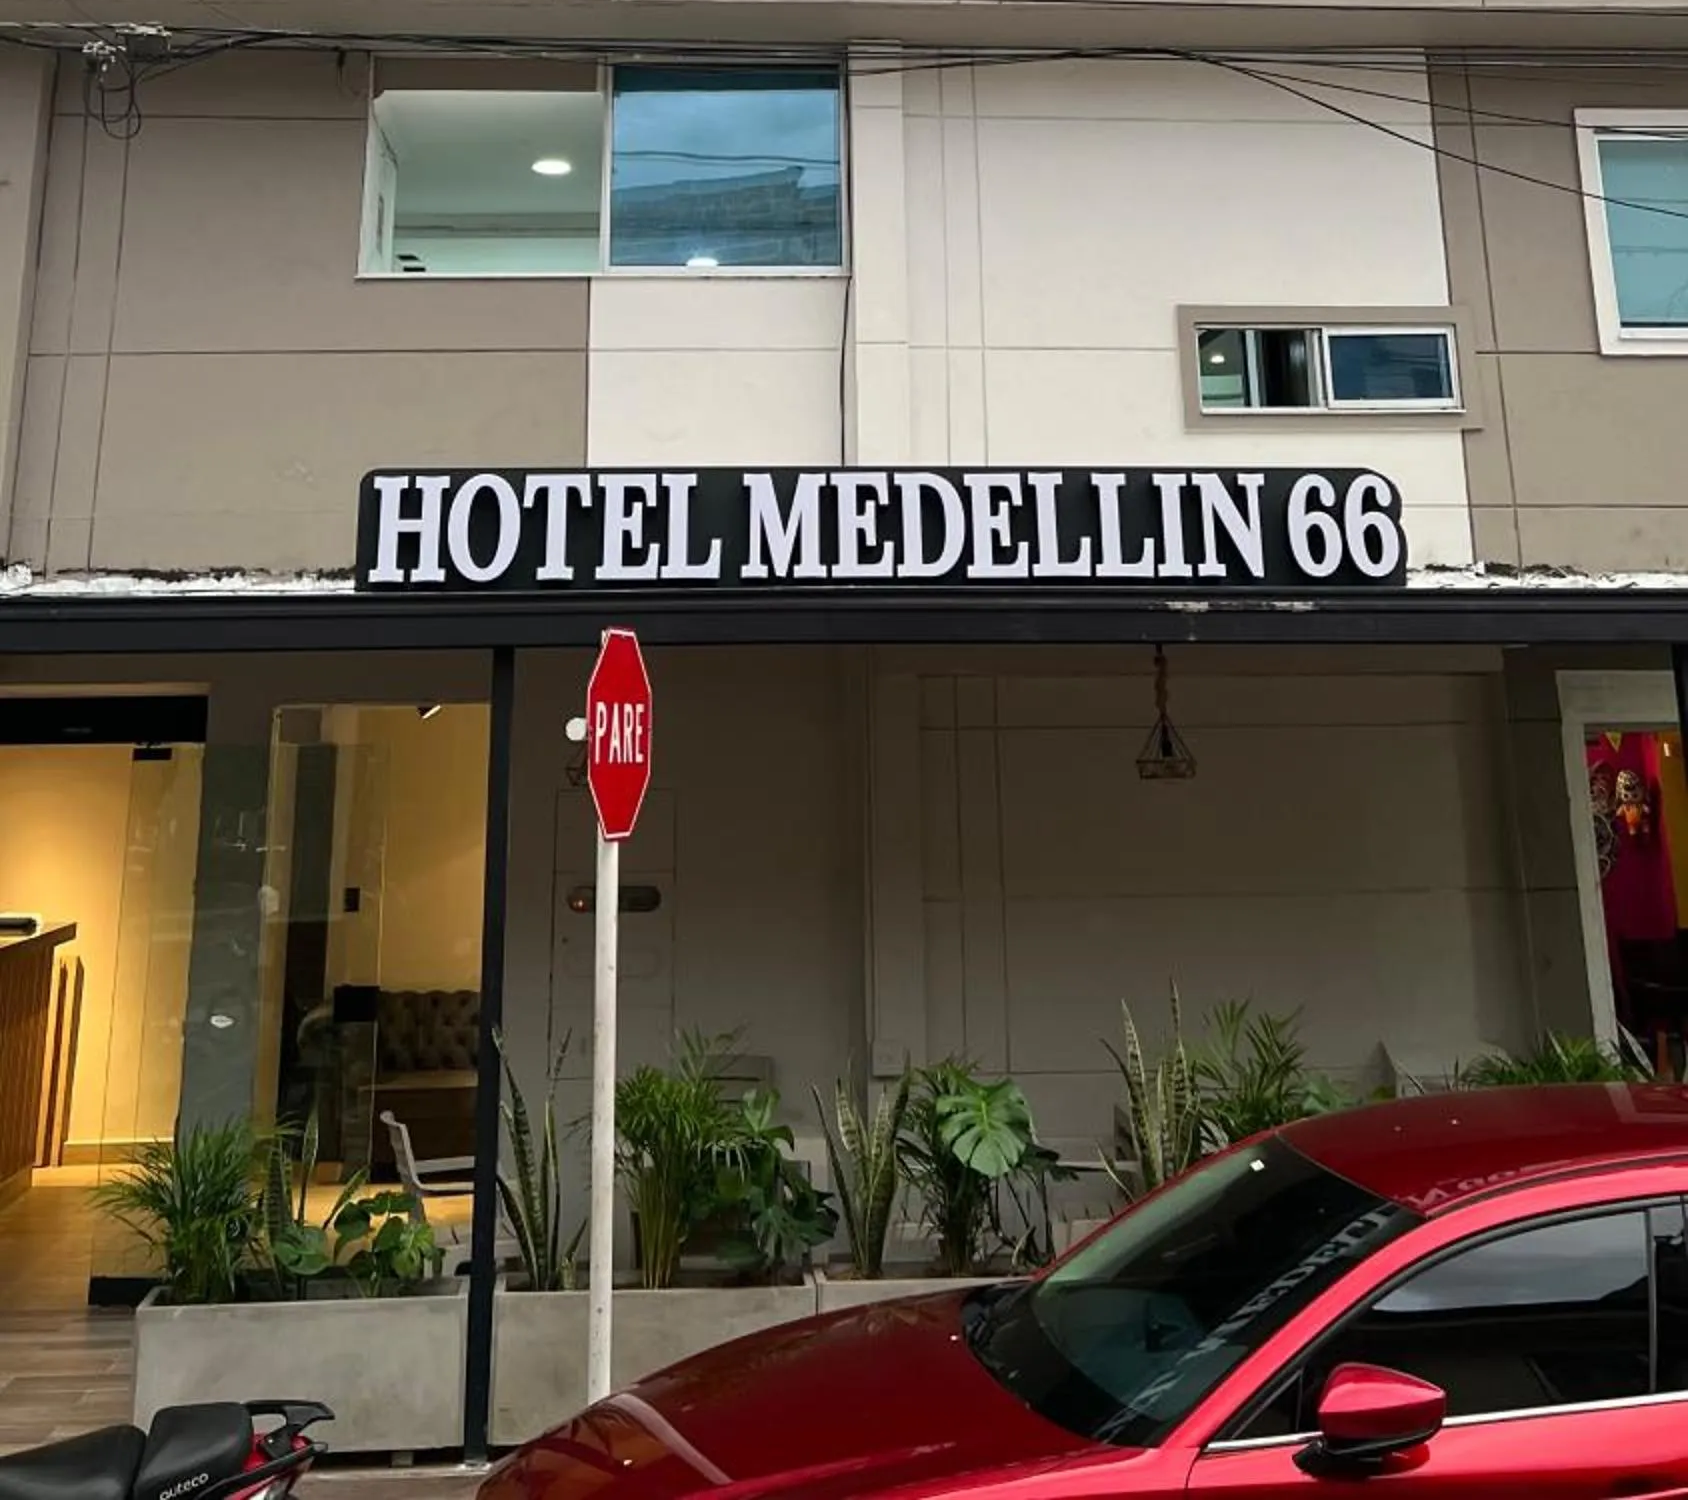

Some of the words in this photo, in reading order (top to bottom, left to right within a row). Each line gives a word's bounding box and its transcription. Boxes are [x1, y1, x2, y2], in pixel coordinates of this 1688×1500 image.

[367, 473, 722, 583] HOTEL
[740, 472, 1266, 580] MEDELLIN
[1287, 473, 1401, 578] 66
[594, 701, 645, 765] PARE
